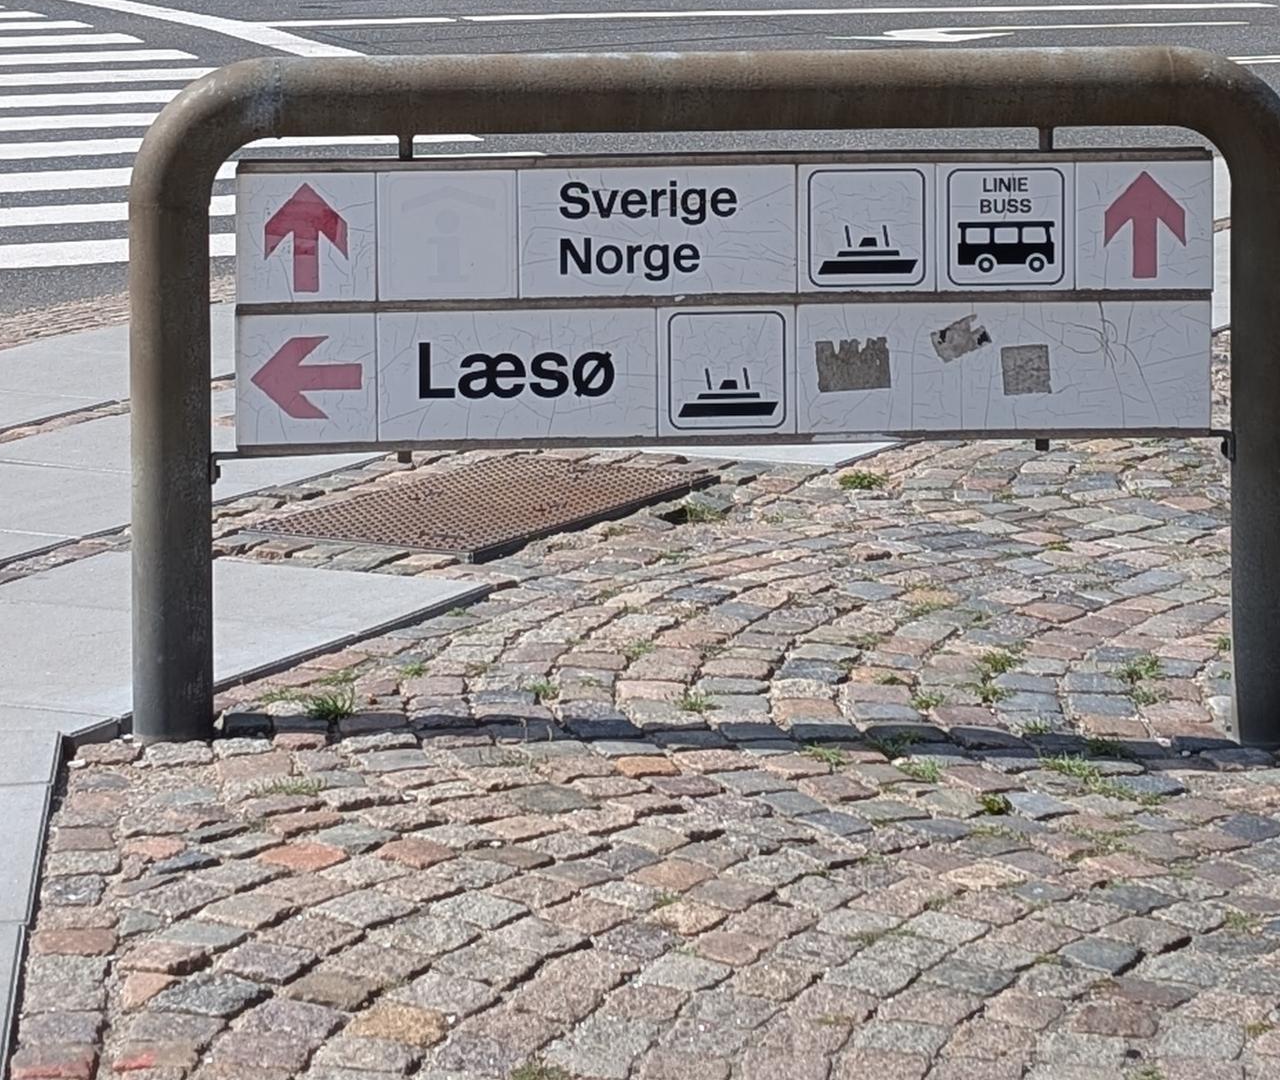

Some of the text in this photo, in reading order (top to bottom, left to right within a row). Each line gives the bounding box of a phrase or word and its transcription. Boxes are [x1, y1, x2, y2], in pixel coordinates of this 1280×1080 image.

[558, 178, 738, 226] Sverige
[980, 198, 1033, 214] BUSS
[982, 176, 1029, 193] LINIE
[558, 237, 701, 282] Norge
[418, 341, 615, 399] Læsø
